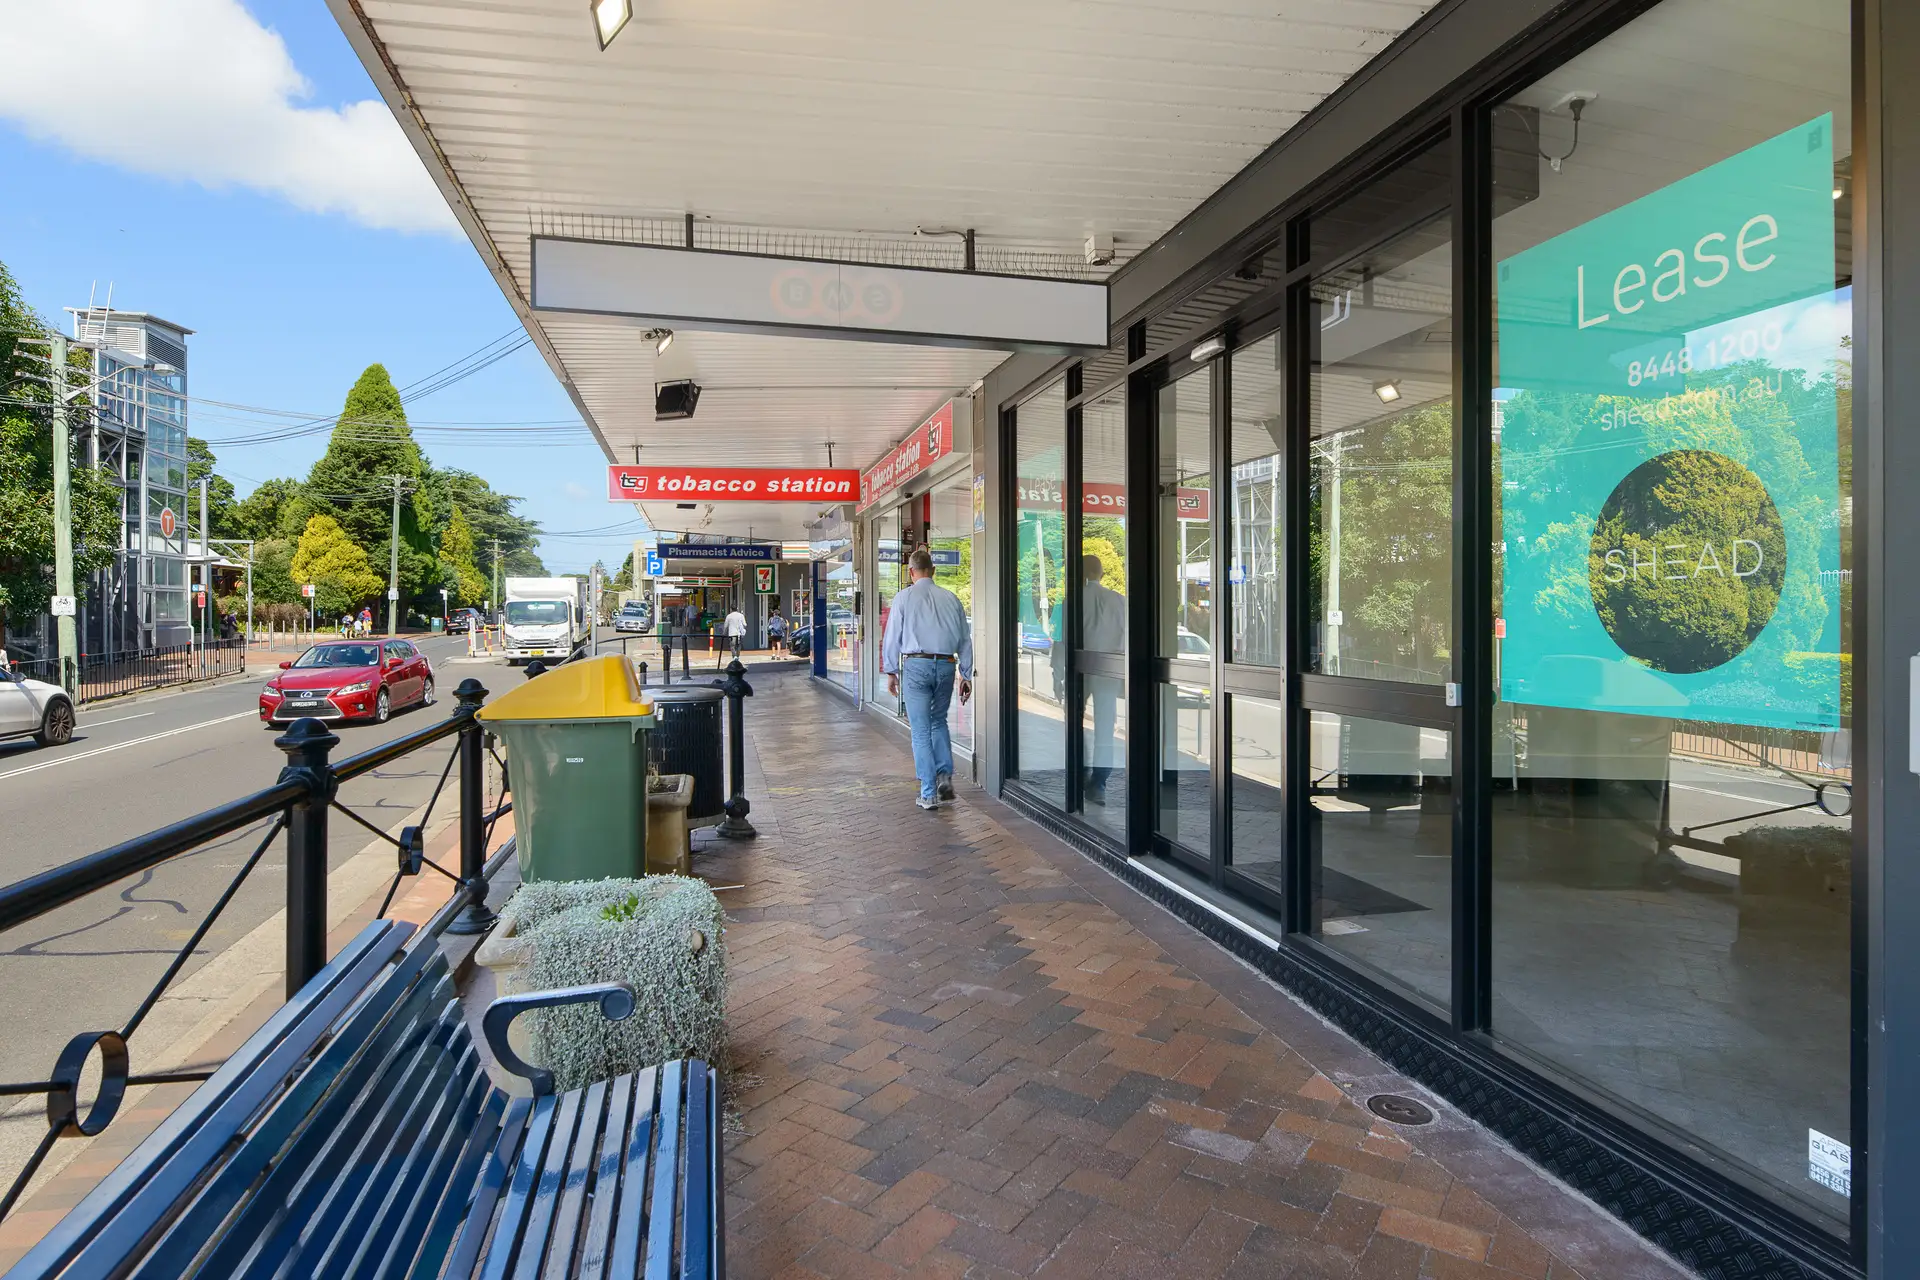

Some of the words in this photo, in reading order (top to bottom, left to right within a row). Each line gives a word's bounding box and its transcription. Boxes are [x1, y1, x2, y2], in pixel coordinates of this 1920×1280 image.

[1577, 213, 1779, 330] Lease
[1627, 347, 1694, 387] 8448
[1705, 321, 1783, 366] 1200
[1600, 372, 1783, 432] shead.com.au
[619, 472, 649, 493] tsg
[656, 475, 757, 493] tobacco
[766, 475, 851, 493] station
[871, 462, 894, 493] tobacco
[895, 440, 921, 475] station
[164, 515, 172, 533] T
[650, 562, 661, 574] P
[668, 547, 728, 557] Pharmacist
[730, 548, 765, 557] Advice
[1604, 539, 1764, 583] SHEAD
